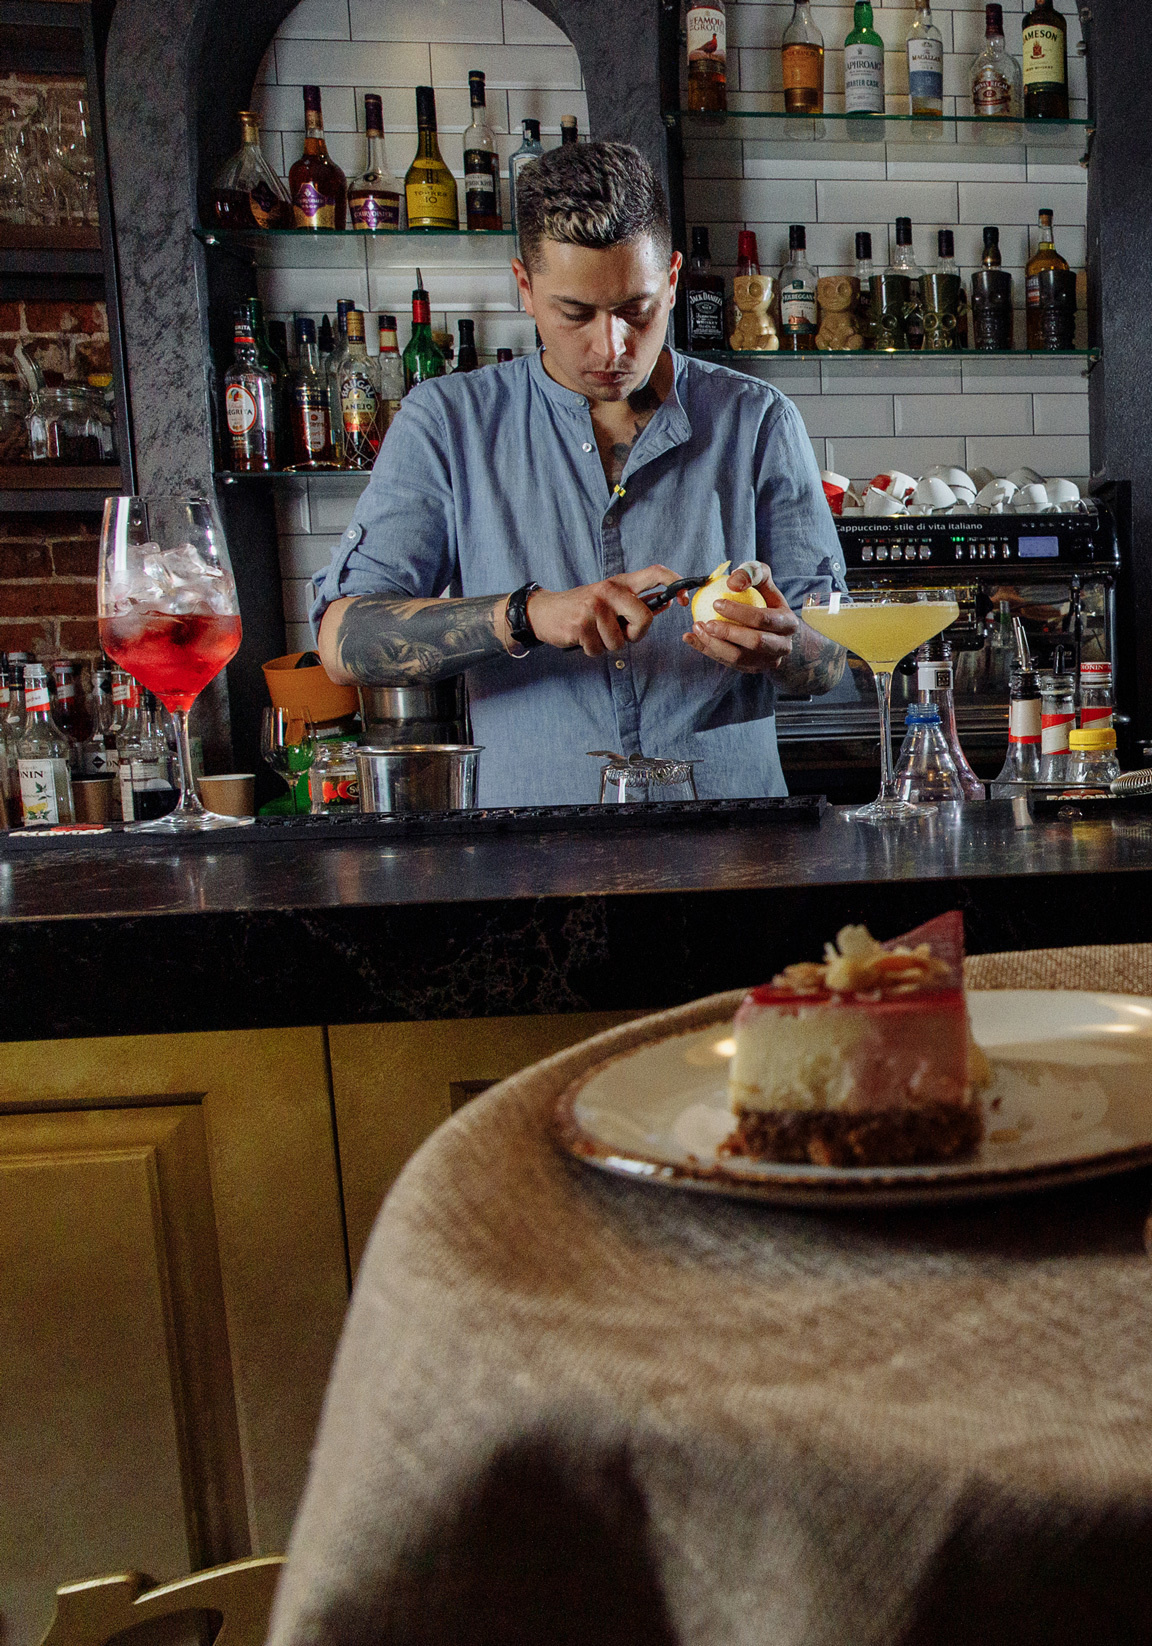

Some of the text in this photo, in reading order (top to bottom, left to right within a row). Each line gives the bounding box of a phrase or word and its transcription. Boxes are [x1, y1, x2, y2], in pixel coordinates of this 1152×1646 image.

[847, 60, 880, 71] APHROAIG
[894, 523, 914, 531] stile
[916, 523, 926, 531] di
[928, 522, 946, 531] vita
[948, 522, 983, 530] italiano
